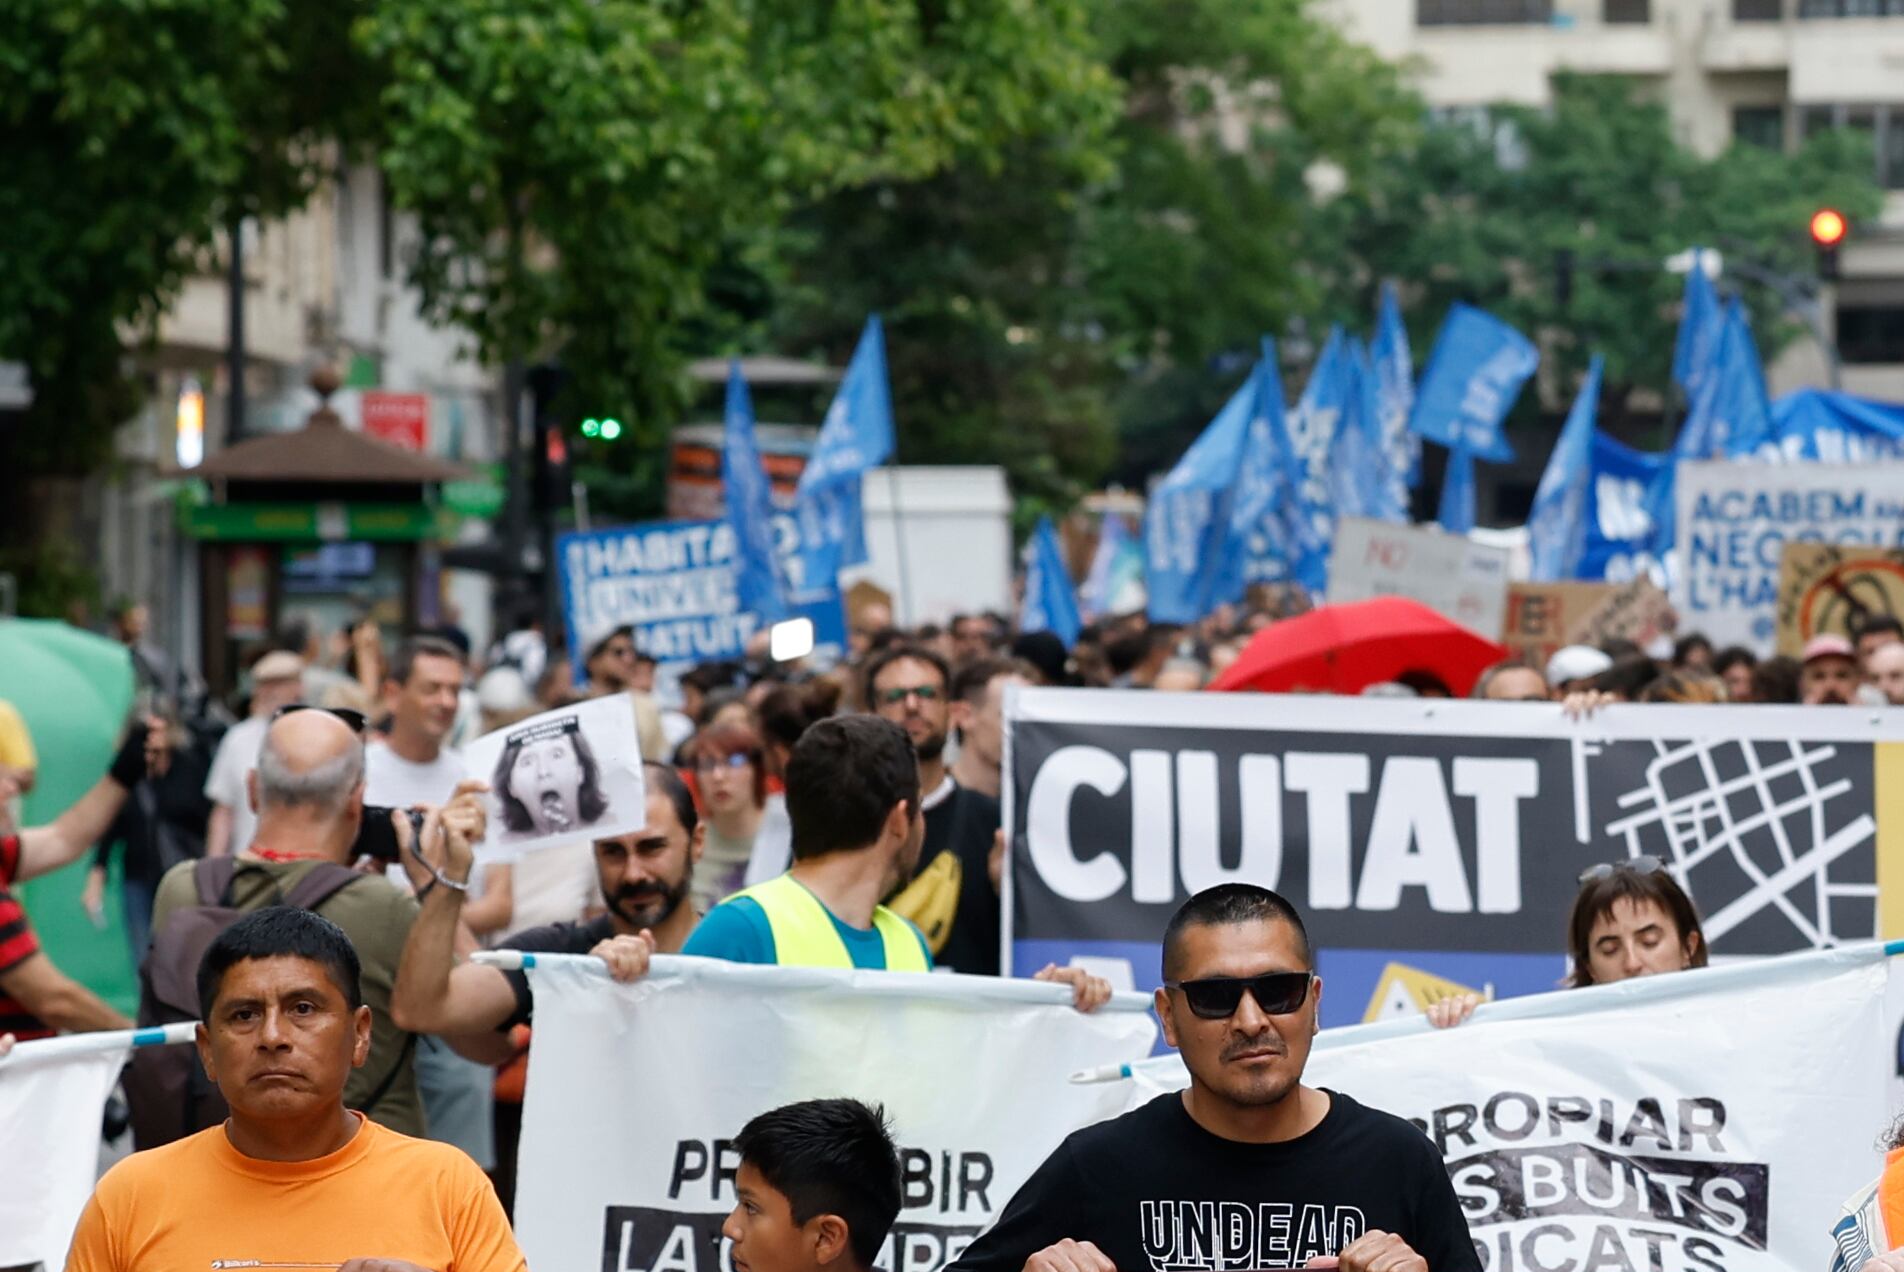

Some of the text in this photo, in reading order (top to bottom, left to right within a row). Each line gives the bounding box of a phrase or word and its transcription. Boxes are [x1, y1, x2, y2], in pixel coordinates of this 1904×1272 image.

[1693, 490, 1866, 523] ACABEM
[587, 524, 738, 574] HABITA
[1028, 744, 1540, 916] CIUTAT
[1409, 1091, 1727, 1154] ROPIAR
[1521, 1154, 1748, 1238] BUITS
[1140, 1200, 1366, 1263] UNDEAD
